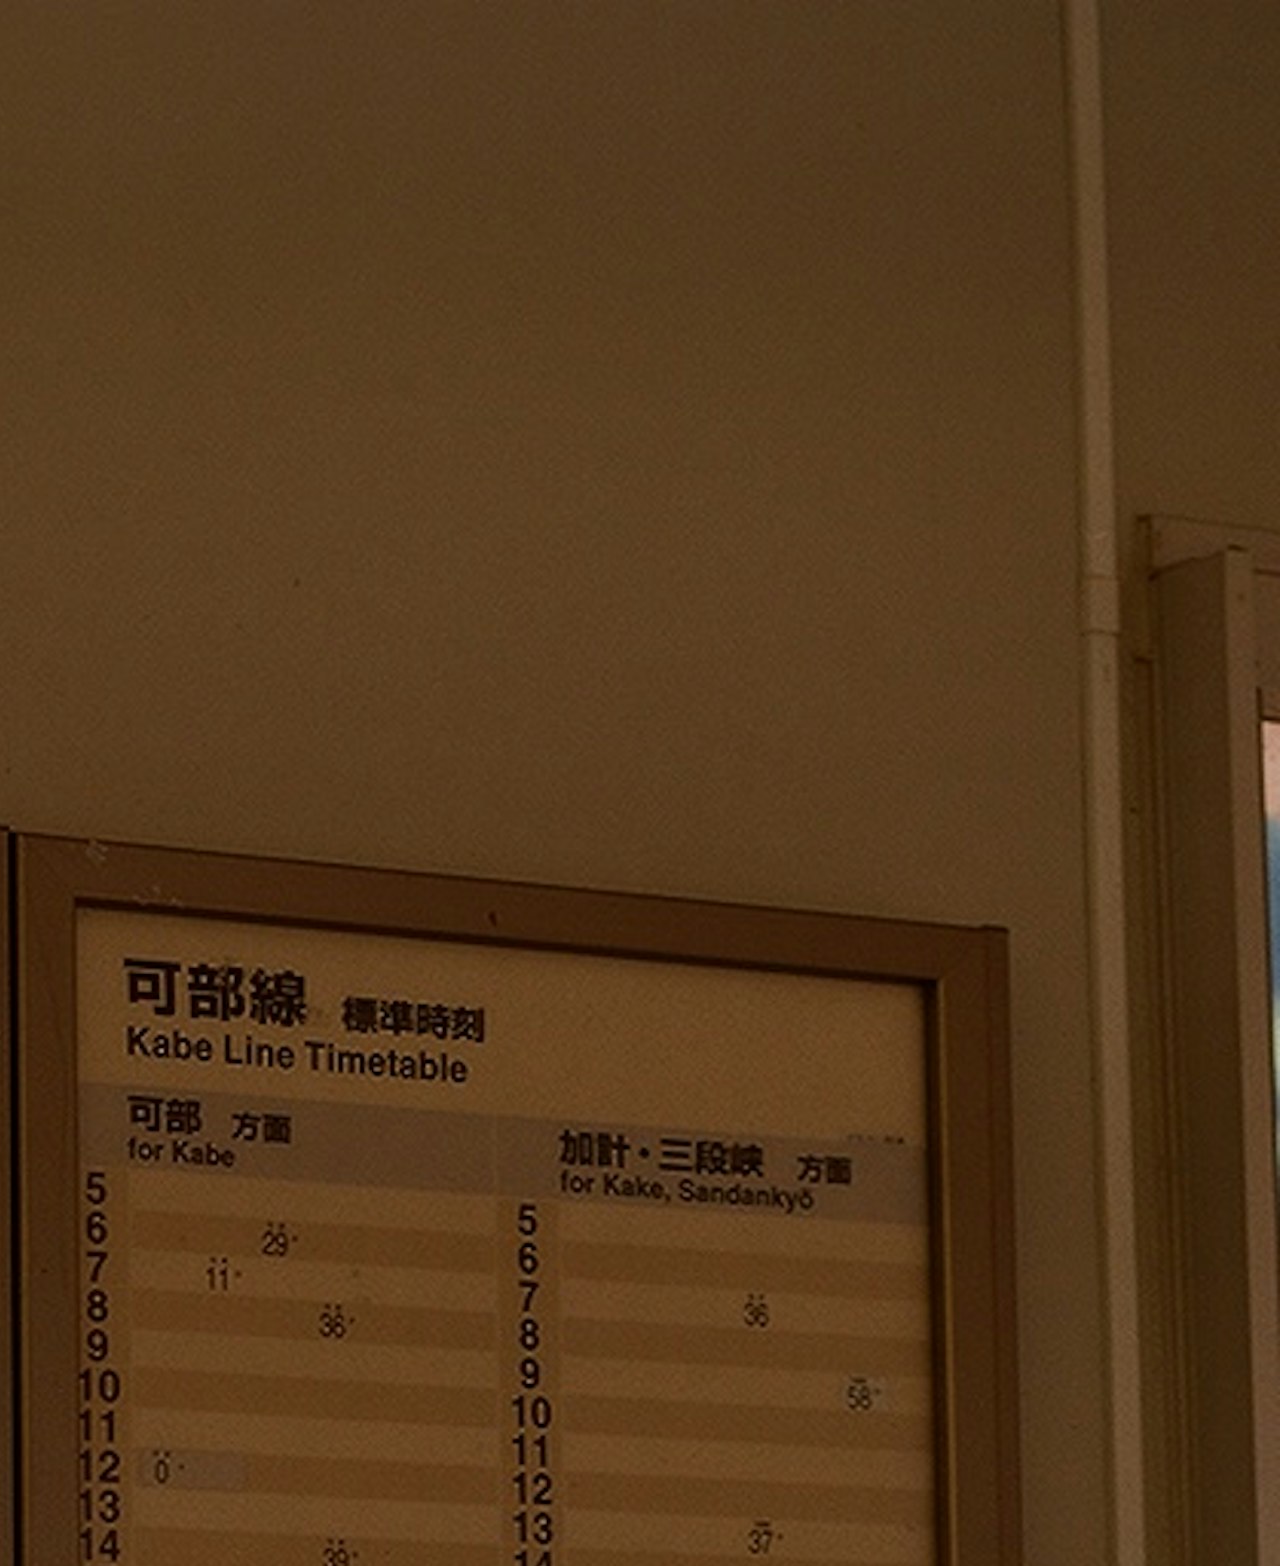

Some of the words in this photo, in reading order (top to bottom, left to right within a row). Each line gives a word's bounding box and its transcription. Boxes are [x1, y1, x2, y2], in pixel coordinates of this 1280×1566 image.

[123, 958, 309, 1027] 可部線
[341, 995, 485, 1043] 標準時刻
[126, 1026, 213, 1062] Kabe
[223, 1036, 295, 1070] Line
[305, 1041, 469, 1084] Timetable
[127, 1095, 201, 1135] 可部
[231, 1113, 292, 1145] 方面
[127, 1136, 164, 1161] for
[172, 1141, 236, 1168] Kabe
[797, 1153, 852, 1185] 方面
[86, 1171, 106, 1204] 5
[560, 1169, 594, 1194] for
[603, 1173, 671, 1203] Kake,
[86, 1211, 107, 1244] 6
[262, 1231, 288, 1256] 29
[518, 1203, 537, 1235] 5
[86, 1250, 107, 1282] 7
[207, 1267, 228, 1290] 11
[518, 1242, 538, 1274] 6
[86, 1289, 108, 1322] 8
[518, 1280, 538, 1311] 7
[86, 1328, 108, 1361] 9
[519, 1318, 539, 1350] 8
[79, 1368, 119, 1402] 10
[520, 1357, 539, 1389] 9
[79, 1409, 114, 1442] 11
[512, 1395, 551, 1428] 10
[79, 1449, 119, 1483] 12
[512, 1434, 546, 1466] 11
[512, 1472, 552, 1505] 12
[79, 1488, 119, 1523] 13
[79, 1527, 120, 1561] 14
[513, 1511, 552, 1544] 13
[748, 1530, 772, 1554] 37
